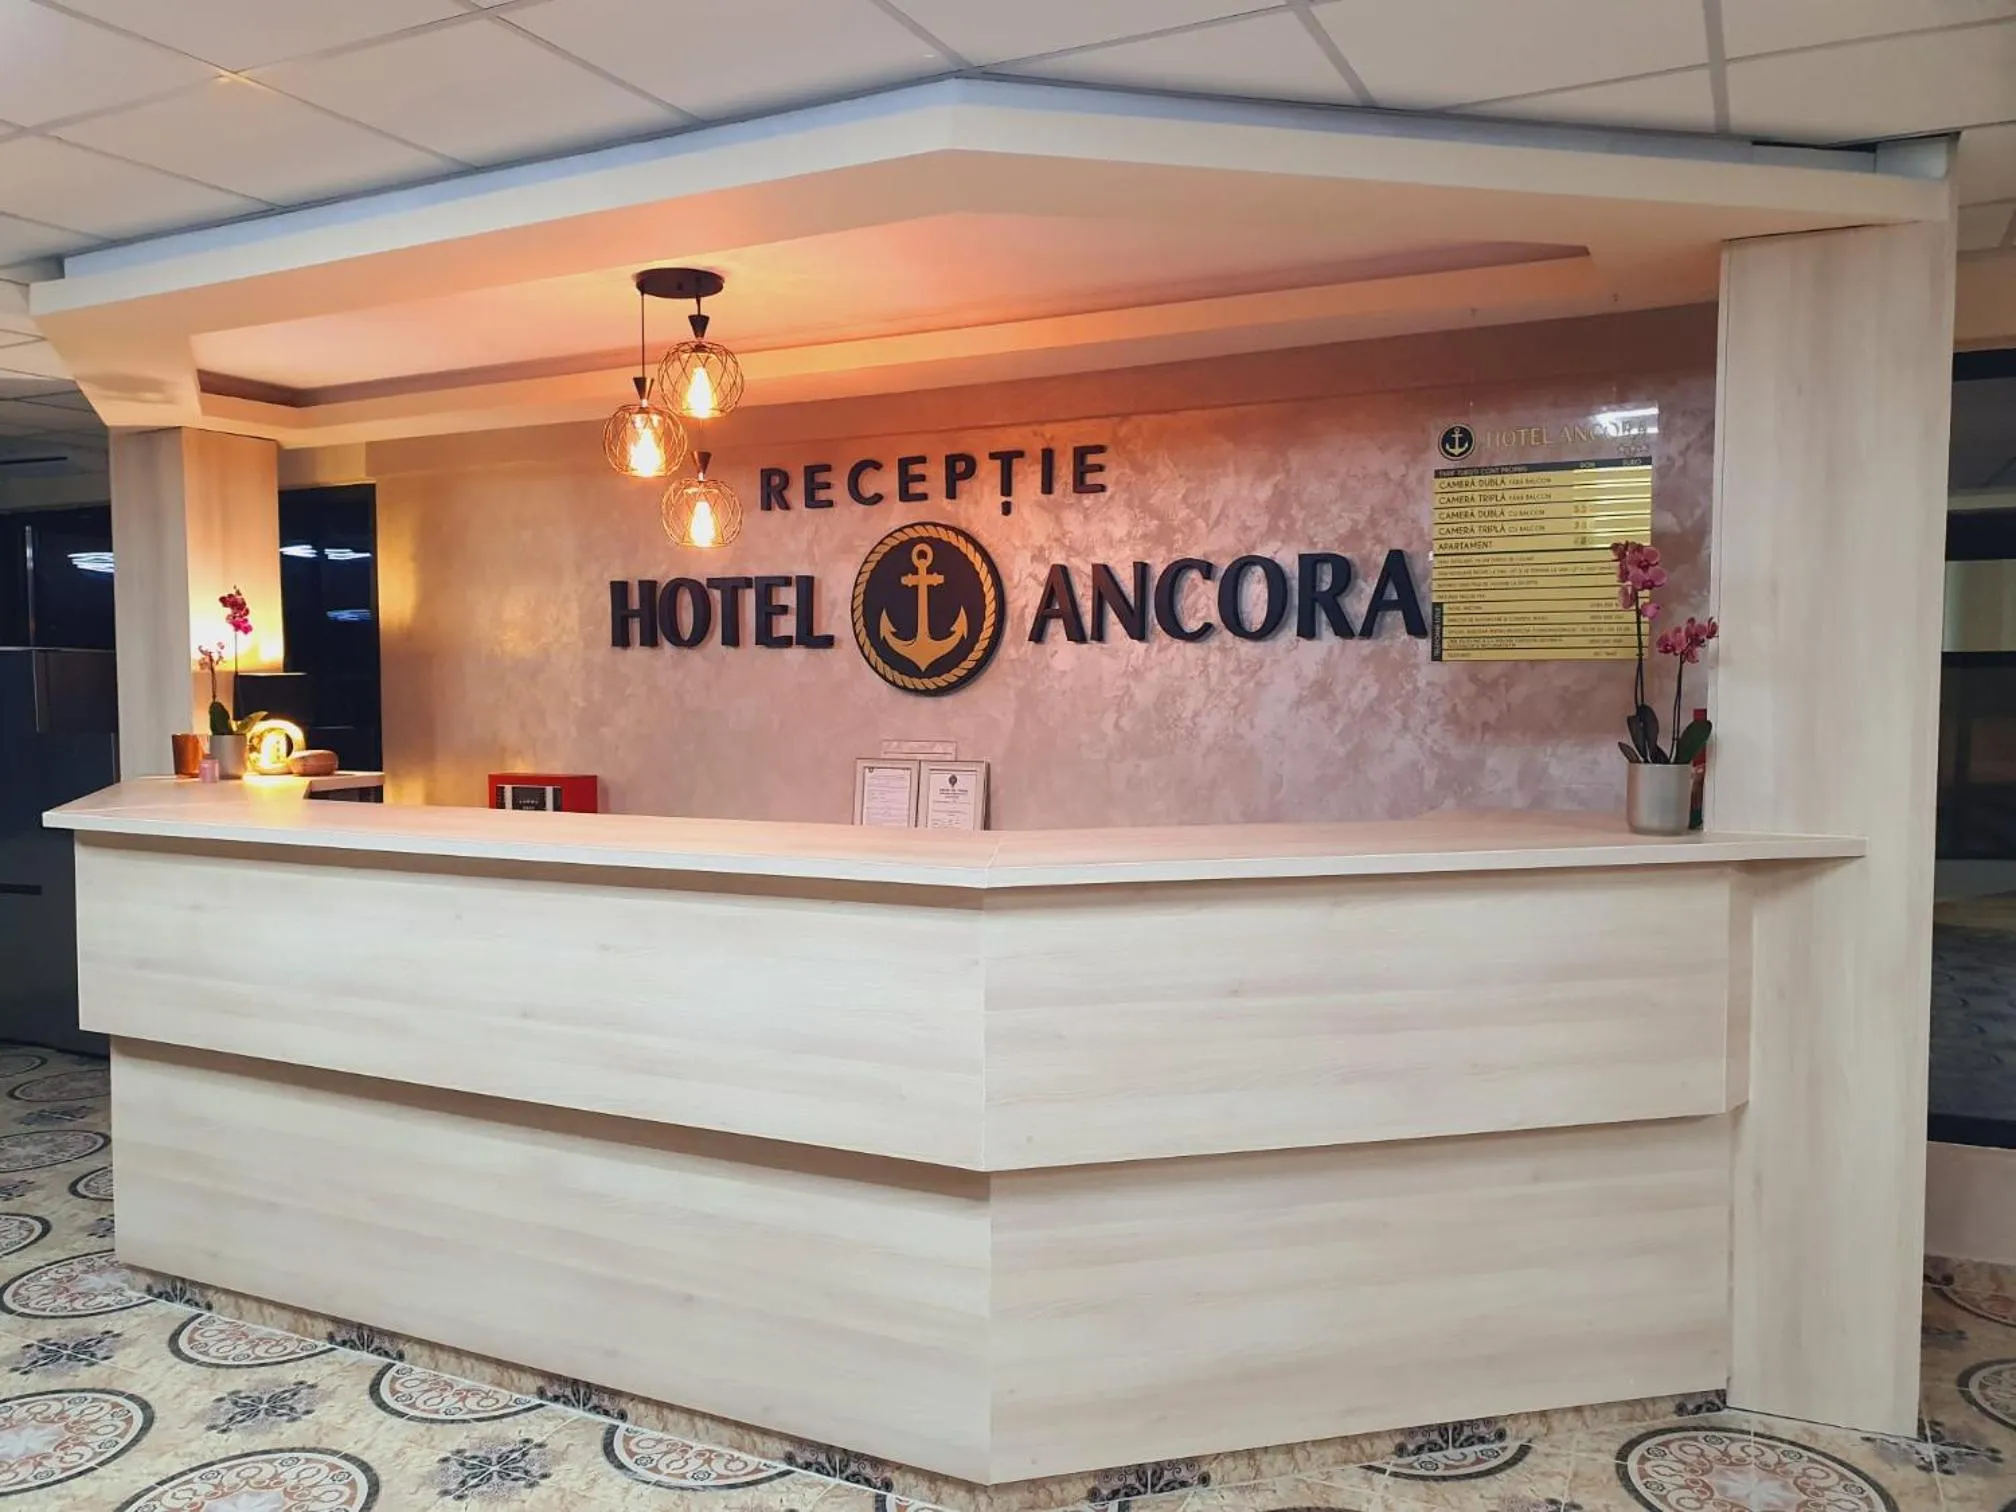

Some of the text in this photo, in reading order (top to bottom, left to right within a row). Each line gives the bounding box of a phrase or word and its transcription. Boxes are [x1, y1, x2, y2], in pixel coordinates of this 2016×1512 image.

[1487, 427, 1552, 448] HOTEL
[760, 445, 1107, 516] RECEPȚIE
[1438, 541, 1493, 551] APARTAMENT
[609, 575, 835, 649] HOTEL
[1028, 549, 1428, 643] ANCORA
